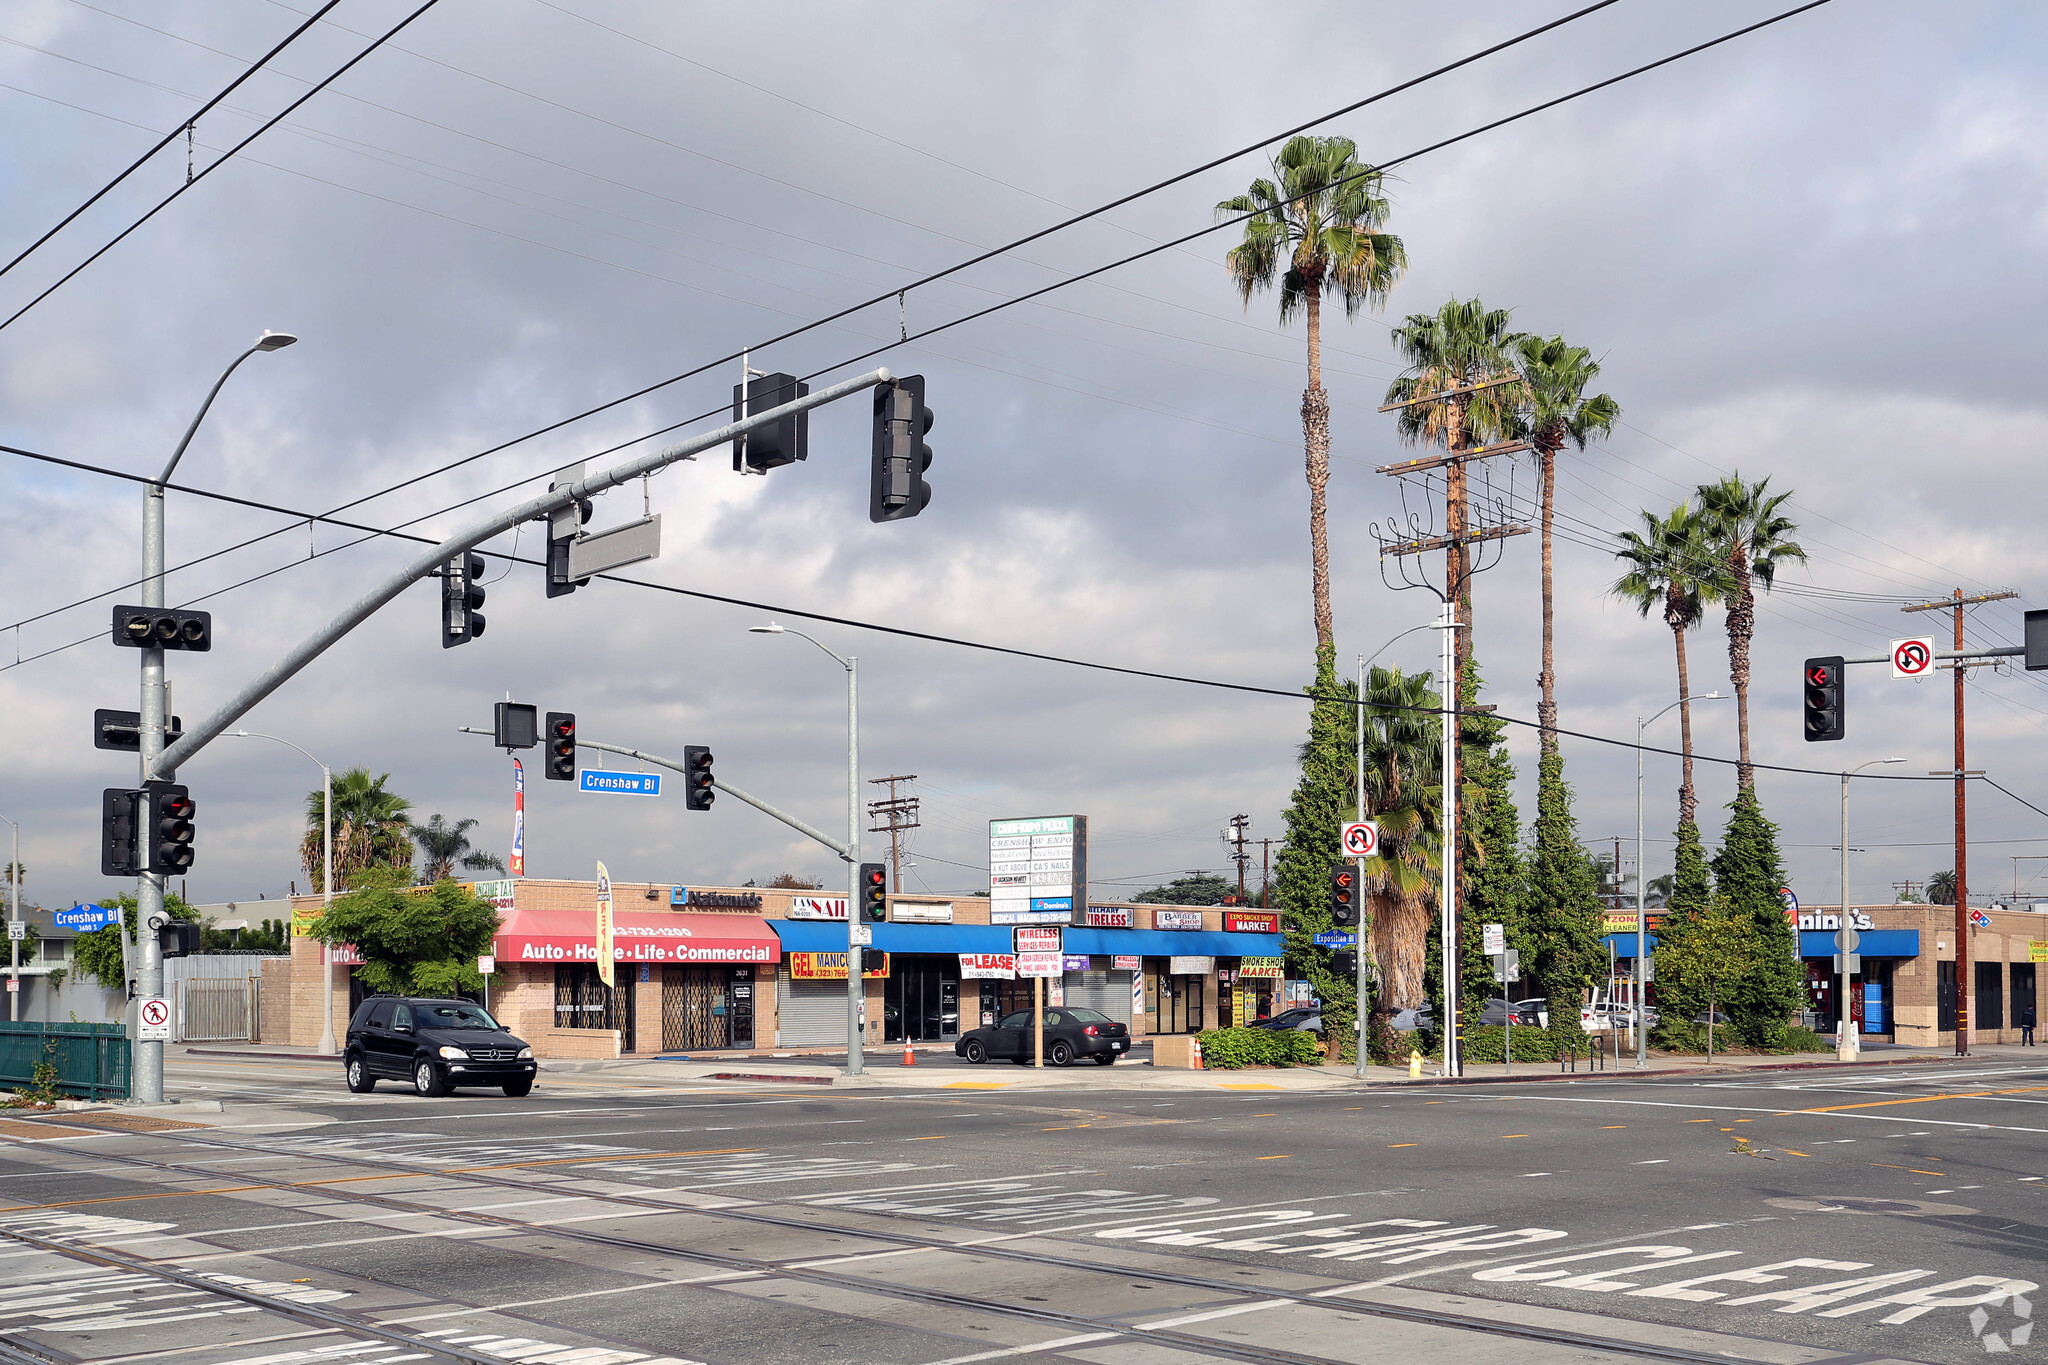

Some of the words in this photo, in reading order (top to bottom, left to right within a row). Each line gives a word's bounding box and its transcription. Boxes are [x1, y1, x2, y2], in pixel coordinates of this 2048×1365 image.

[587, 774, 639, 789] Crenshaw
[644, 779, 655, 791] Bl
[992, 837, 1043, 848] CRENSHAW
[1047, 836, 1072, 845] EXPO
[1010, 863, 1028, 871] ABOVE
[1050, 861, 1070, 870] NAILS
[476, 881, 498, 898] INCOME
[499, 880, 513, 897] TAX
[688, 890, 763, 907] Nationwide
[1043, 901, 1069, 909] Domino's
[56, 911, 104, 924] Crenshaw
[107, 908, 118, 921] Bl
[1164, 912, 1197, 921] BARBER
[1179, 918, 1200, 926] SHOP
[1236, 921, 1270, 931] MARKET
[78, 924, 92, 932] 3600
[611, 926, 692, 937] 23-732-1200
[10, 930, 23, 938] 35
[1018, 928, 1058, 940] WIRELESS
[1316, 934, 1347, 944] Exposition
[332, 946, 350, 963] uto
[522, 943, 563, 959] Auto
[575, 944, 625, 960] Hoe
[634, 944, 666, 960] Life
[676, 944, 770, 961] Commercial
[792, 952, 813, 977] GEL
[816, 953, 849, 967] MANICU
[961, 957, 974, 967] FOR
[975, 954, 1013, 970] LEASE
[1241, 957, 1265, 966] SMOKE
[1266, 957, 1284, 967] SHOP
[815, 969, 834, 977] (323)
[1240, 967, 1282, 977] MARKET
[804, 1183, 1221, 1224] CLEAR
[1094, 1209, 1569, 1265] CLEAR
[1471, 1245, 2040, 1325] CLEAR
